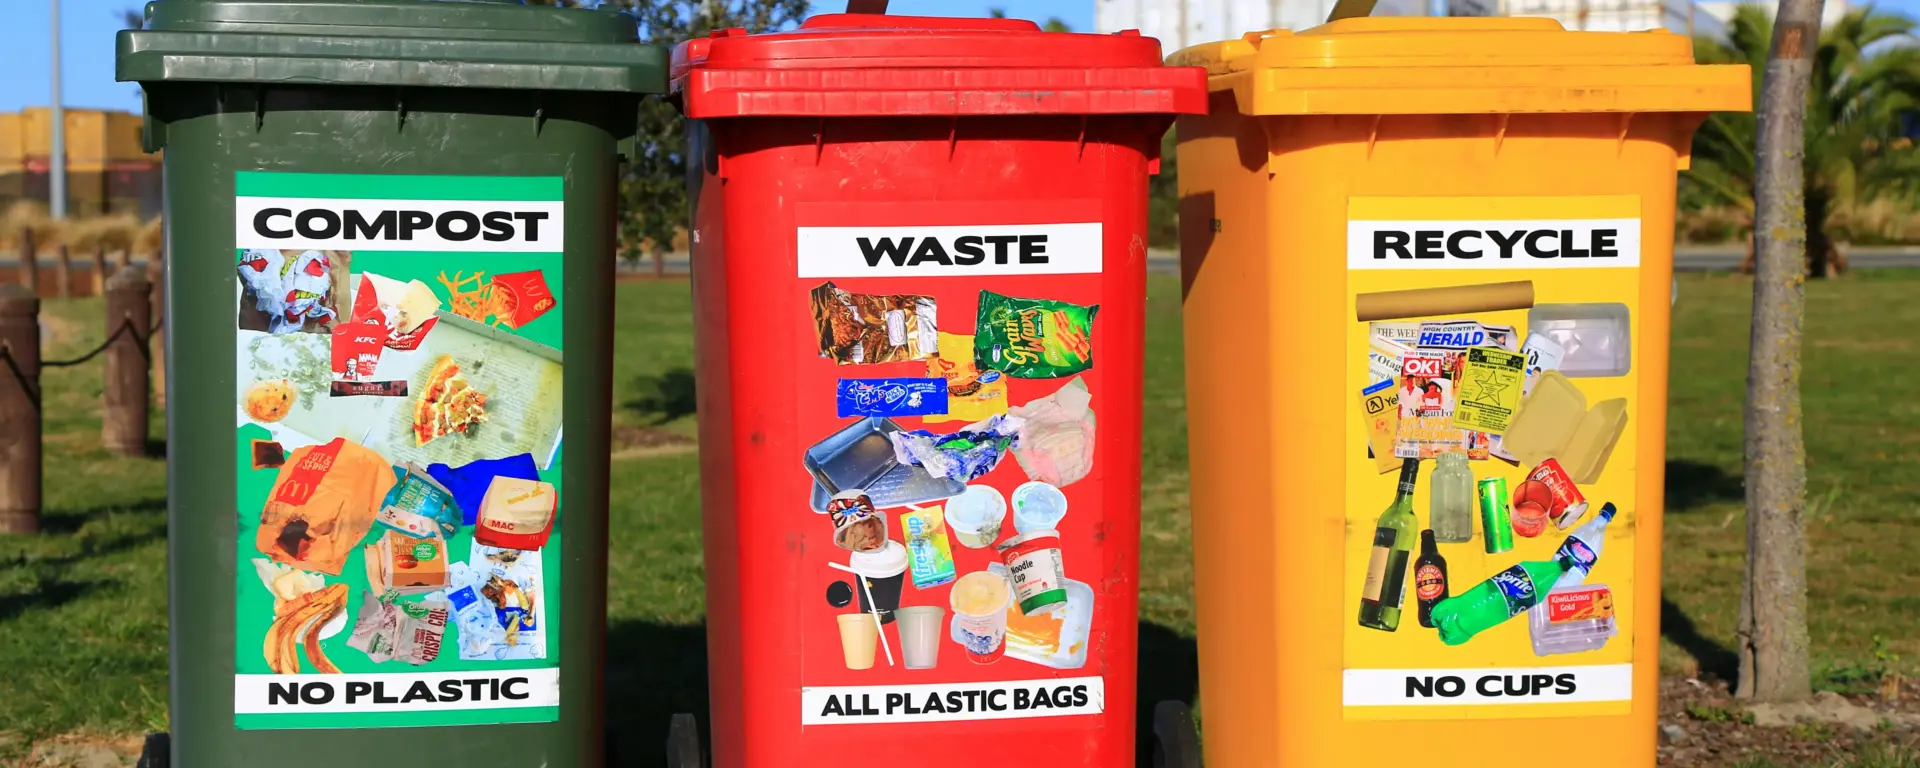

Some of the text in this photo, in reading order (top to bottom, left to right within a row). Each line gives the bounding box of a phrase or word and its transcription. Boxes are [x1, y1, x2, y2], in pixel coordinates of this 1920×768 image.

[253, 207, 549, 242] COMPOST
[856, 234, 1049, 267] WASTE
[1373, 229, 1619, 260] RECYCLE
[354, 336, 377, 344] KFC
[1397, 328, 1418, 338] WEE
[1419, 331, 1484, 346] HERALD
[1405, 359, 1440, 374] OK!
[1409, 408, 1439, 419] Mgan
[491, 520, 514, 531] MAC
[1010, 560, 1034, 575] Noodle
[1013, 573, 1026, 584] Cup
[1493, 571, 1533, 593] Sprite
[1560, 603, 1576, 612] Gold
[268, 678, 530, 705] NO PLASTIC
[1405, 674, 1577, 698] NO CUPS
[821, 685, 1089, 717] ALL PLASTIC BAGS
